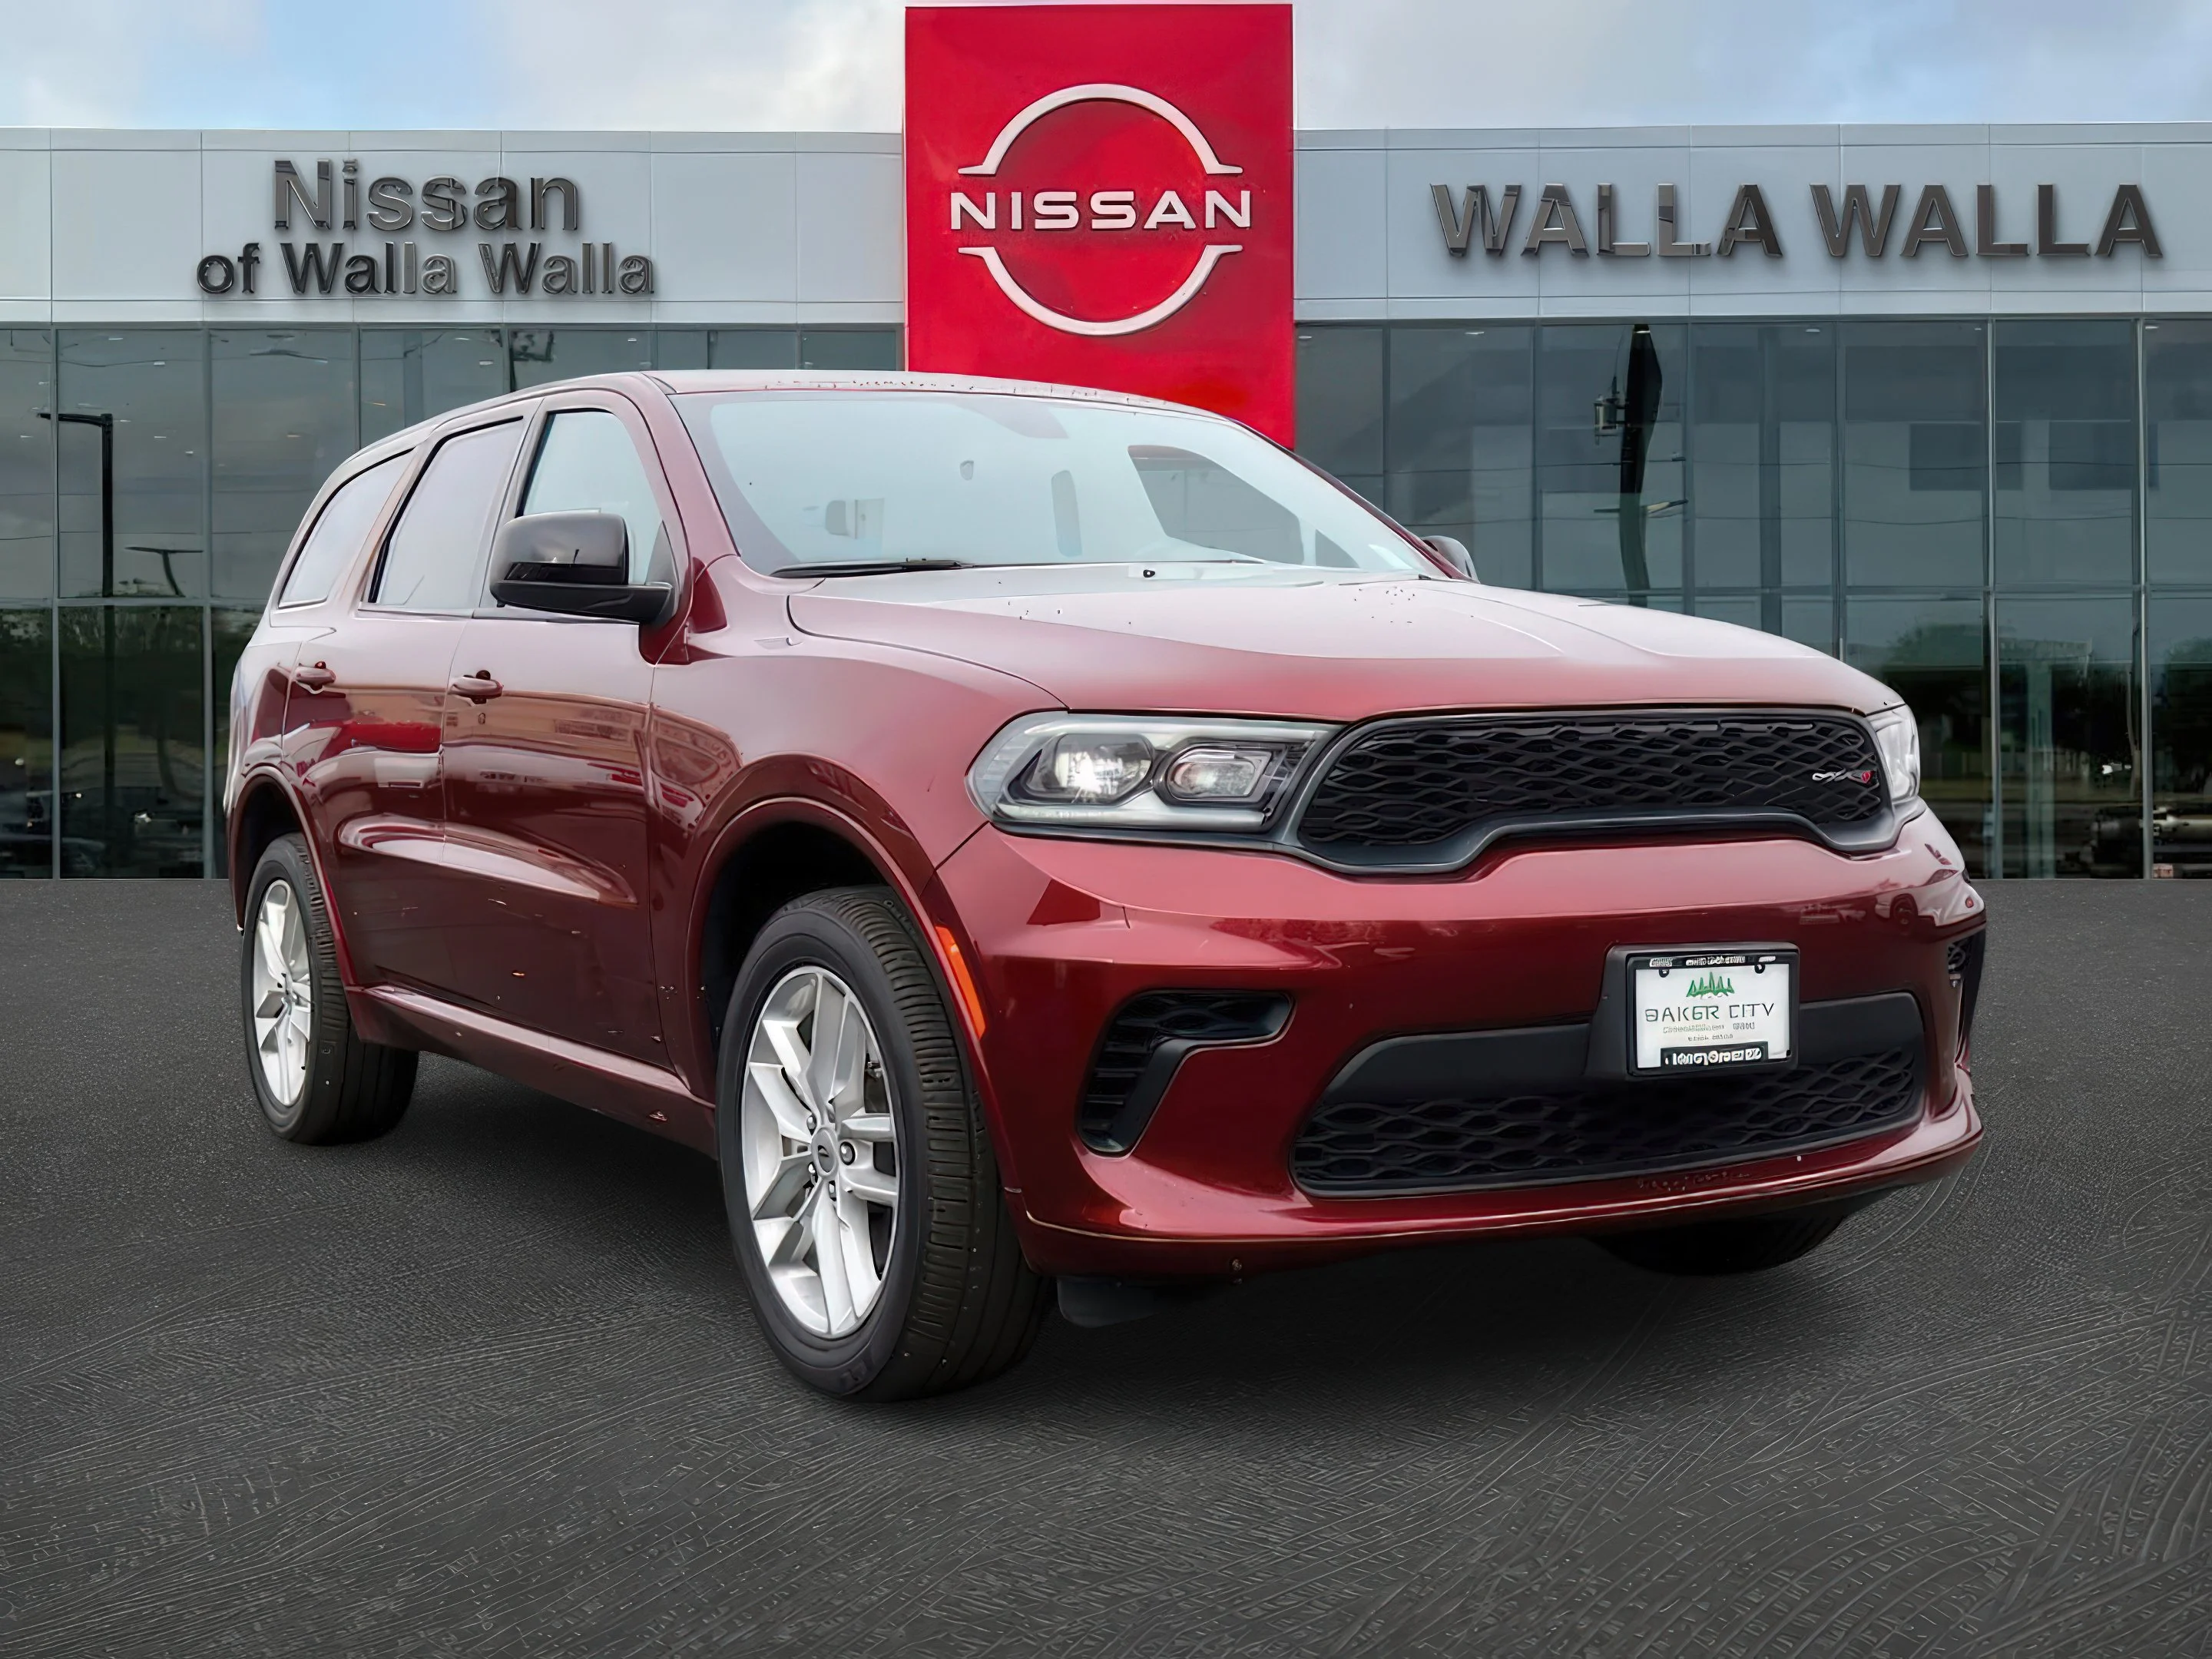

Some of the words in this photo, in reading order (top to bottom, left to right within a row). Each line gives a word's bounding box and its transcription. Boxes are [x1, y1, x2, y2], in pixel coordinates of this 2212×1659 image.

[273, 158, 578, 230] Nissan
[950, 190, 1251, 230] NISSAN
[1429, 181, 1784, 259] WALLA
[1809, 181, 2164, 259] WALLA
[196, 242, 260, 296] of
[280, 241, 459, 295] Walla
[477, 241, 655, 295] Walla
[1729, 1002, 1775, 1019] CITY
